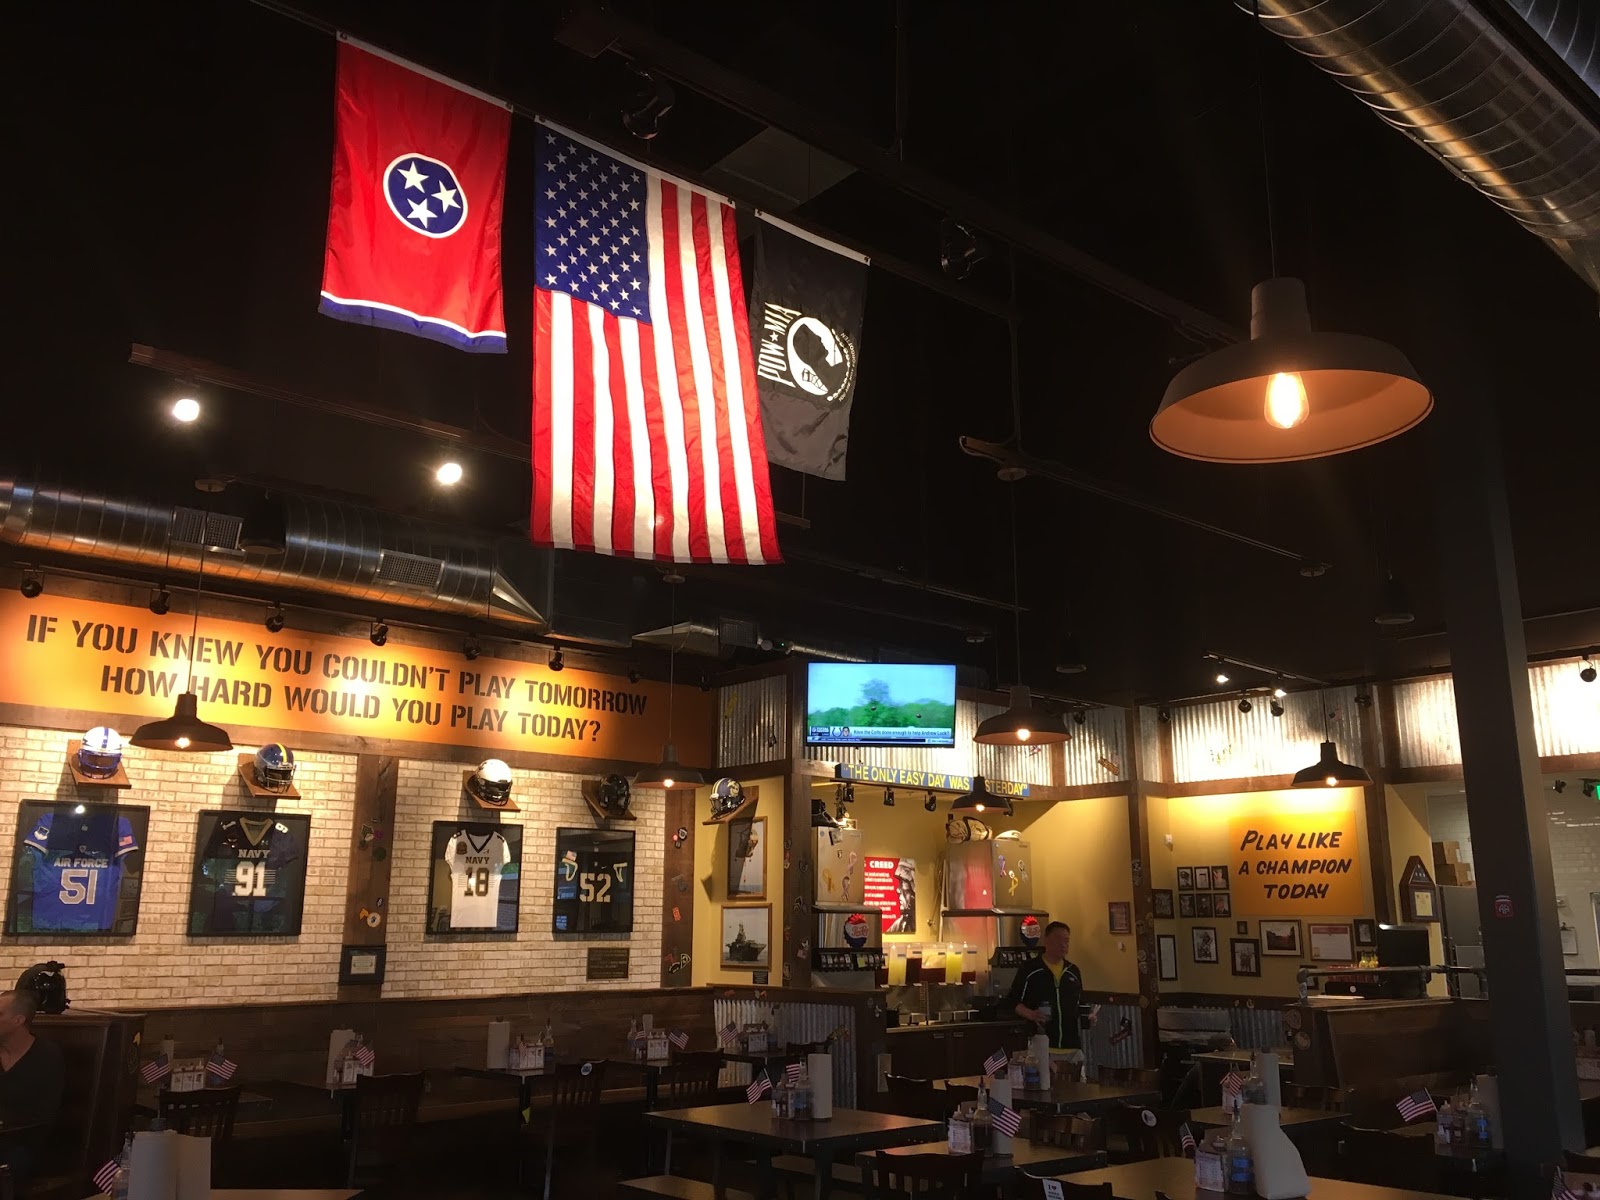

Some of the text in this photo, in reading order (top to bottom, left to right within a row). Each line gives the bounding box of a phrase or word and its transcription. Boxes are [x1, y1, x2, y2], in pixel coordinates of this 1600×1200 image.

[757, 302, 802, 388] POW MIA
[26, 614, 647, 716] IF YOU KNEW YOU COULDN'T PLAY TOMORROW
[100, 665, 601, 742] HOW HARD WOULD YOU PLAY TODAY?
[871, 767, 897, 784] ONLY
[900, 770, 926, 786] EASY
[928, 773, 947, 788] DAY
[949, 776, 970, 791] WAS
[985, 780, 1028, 796] STERDAY"
[238, 849, 271, 858] NAVY
[1240, 830, 1342, 851] PLAY LIKE
[53, 858, 109, 869] AIR FORCE
[465, 856, 490, 865] NAVY
[869, 860, 894, 869] CREED
[1238, 858, 1352, 875] A CHAMPION
[59, 869, 99, 905] 51
[234, 861, 267, 897] 91
[464, 866, 490, 897] 18
[579, 872, 611, 903] 52
[1263, 883, 1329, 900] TODAY
